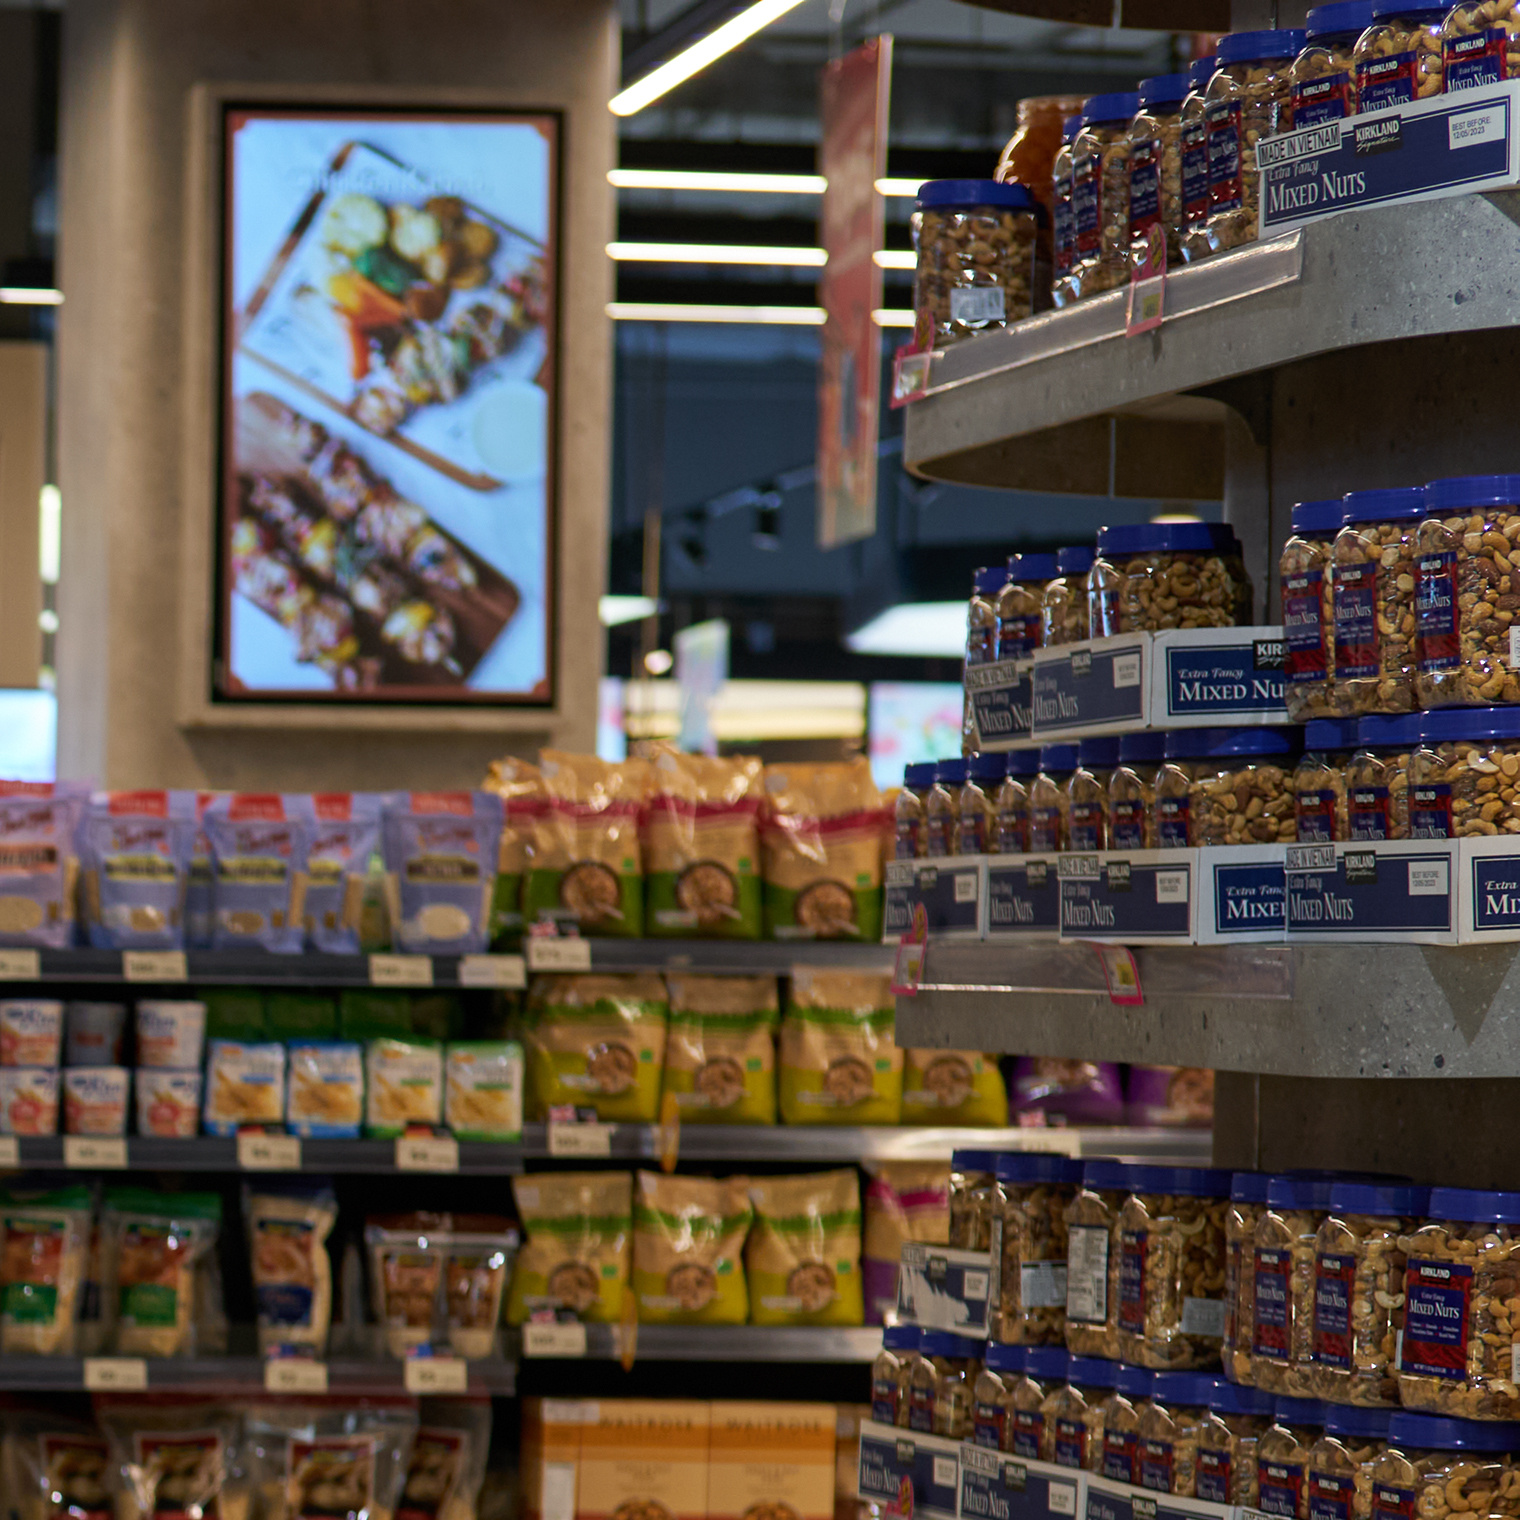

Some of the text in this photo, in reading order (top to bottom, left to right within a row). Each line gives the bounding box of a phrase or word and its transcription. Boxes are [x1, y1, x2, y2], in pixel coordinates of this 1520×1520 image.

[1455, 38, 1485, 53] KIRKLAND
[1369, 60, 1398, 75] KIRKLAND
[1355, 121, 1399, 142] KIRKLAND
[1452, 120, 1466, 131] BEST
[1260, 127, 1340, 165] MADE IN VIETNAM
[1293, 159, 1319, 178] Fancy
[1268, 171, 1366, 214] MIXED NUTS
[1178, 667, 1244, 682] Extra Fancy
[1178, 681, 1247, 703] MIXED
[1290, 894, 1354, 920] MIXED NUTS
[1420, 1266, 1450, 1280] KIRKLAND
[1409, 1298, 1460, 1320] MIXED NUTS
